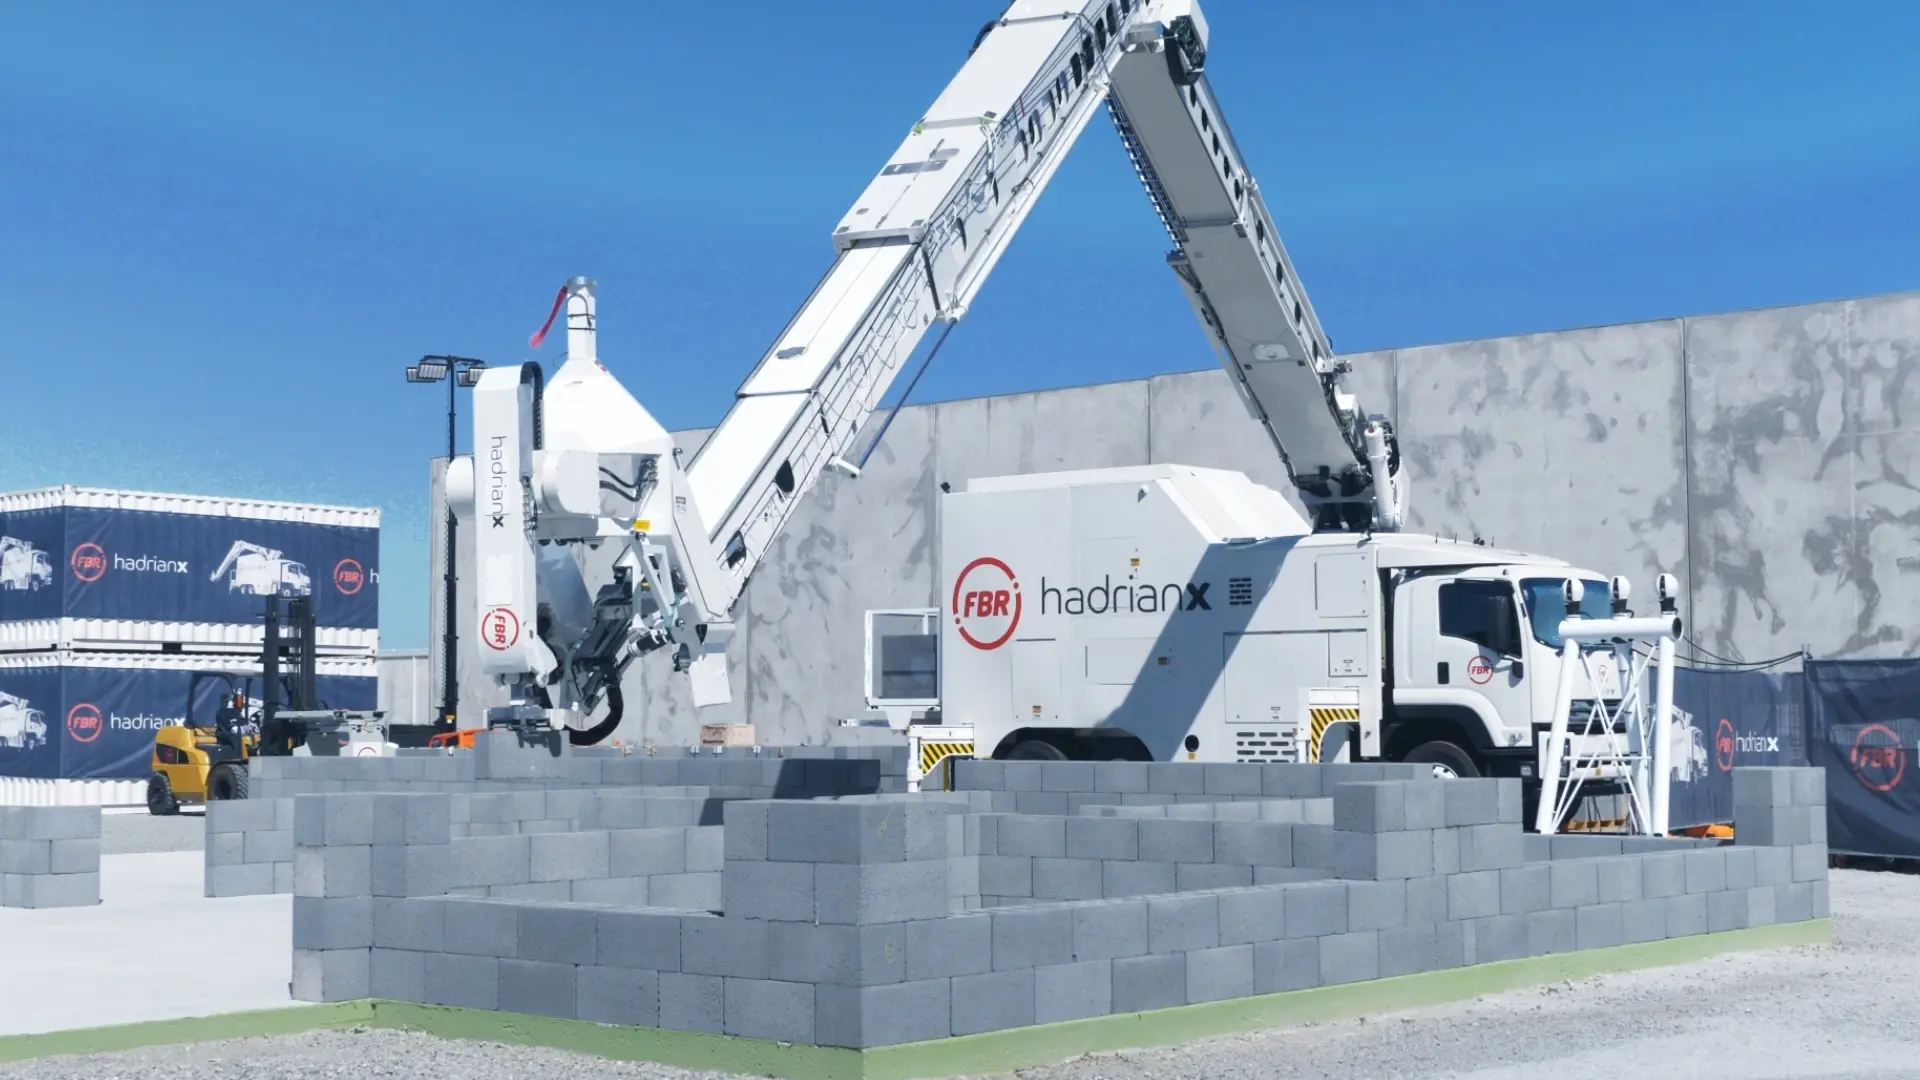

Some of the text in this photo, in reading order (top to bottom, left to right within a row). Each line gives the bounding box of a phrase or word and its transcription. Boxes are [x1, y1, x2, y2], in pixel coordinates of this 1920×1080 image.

[490, 435, 508, 529] hadrianx
[77, 551, 189, 574] FBR hadrianx
[338, 570, 361, 583] FBR
[963, 574, 1213, 618] FBR hadrianx
[494, 614, 506, 644] FBR
[1471, 664, 1490, 676] FBR
[72, 715, 99, 729] FBR
